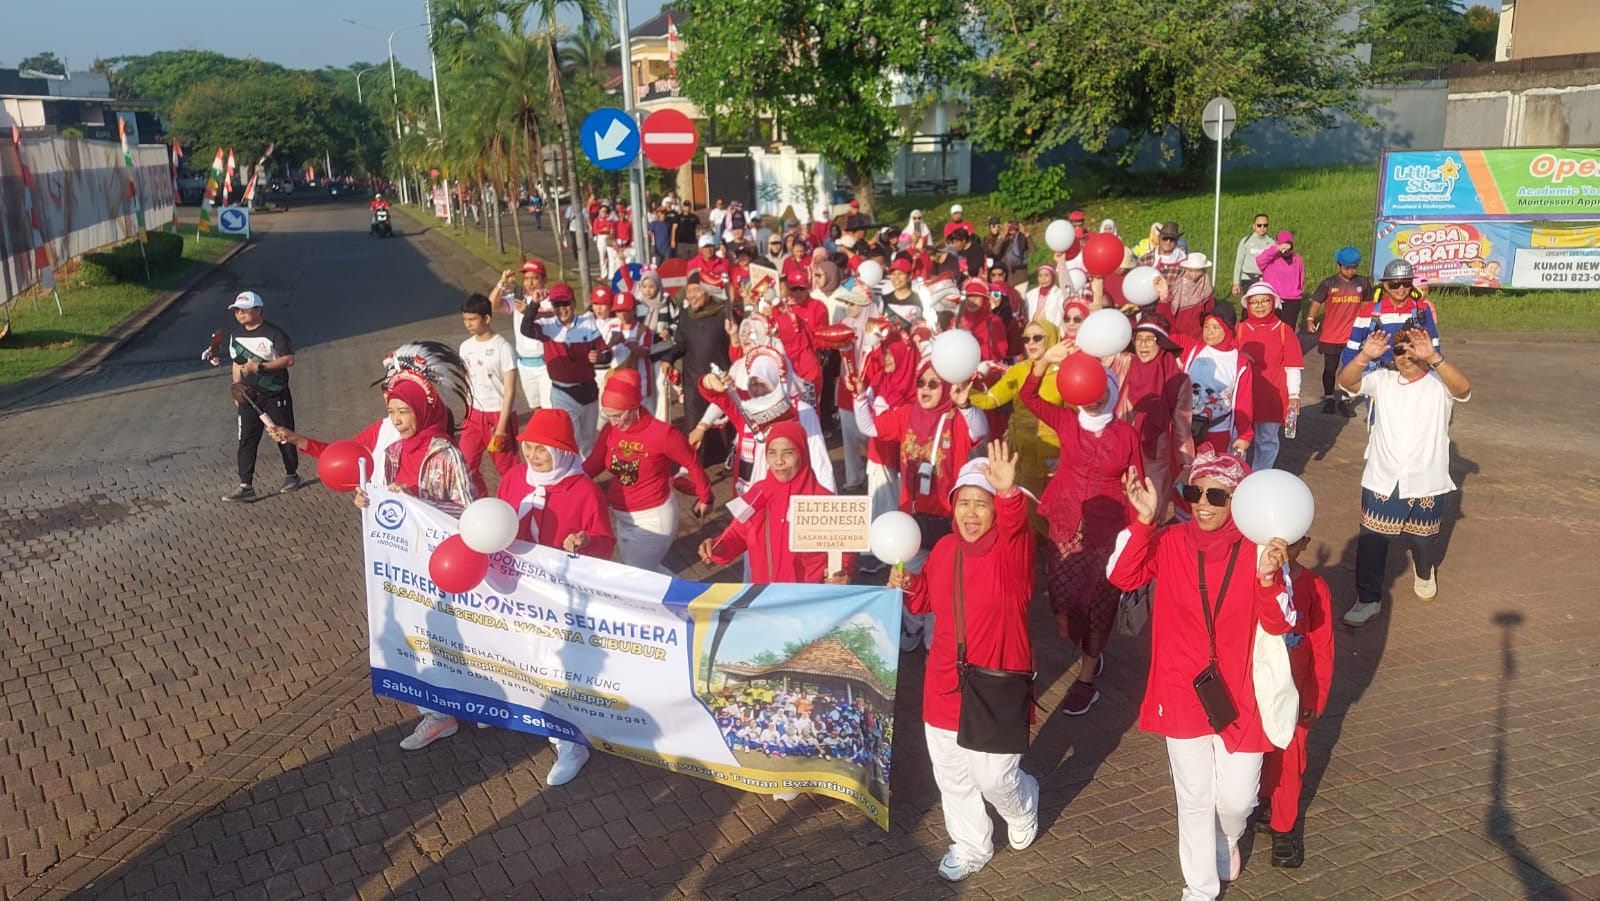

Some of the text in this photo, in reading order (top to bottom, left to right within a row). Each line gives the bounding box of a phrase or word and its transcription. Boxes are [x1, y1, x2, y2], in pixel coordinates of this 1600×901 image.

[1394, 165, 1441, 180] Little
[1530, 153, 1600, 183] Ope
[1406, 179, 1447, 192] Star
[1517, 186, 1578, 197] Academic
[1518, 198, 1574, 206] Montessori
[1409, 228, 1459, 246] COBA
[1404, 243, 1479, 265] GRATIS
[1534, 262, 1600, 270] KUMON NEW
[1541, 273, 1568, 281] (021)
[797, 502, 866, 512] ELTEKERS
[796, 515, 866, 526] INDONESIA
[370, 530, 409, 546] ELTEKERS
[376, 539, 409, 552] INDONESIA
[488, 551, 547, 579] NDONESIA
[373, 561, 678, 647] ELTEKERS INDONESIA SEJAHTERA
[383, 581, 667, 662] SASANA LEGENDA WISATA CIBUBUR
[414, 625, 621, 692] TERAPI KESEHATAN LING TIEN KUNG
[397, 648, 426, 665] Sehat
[432, 660, 463, 675] tanpa
[502, 679, 536, 696] tanpa
[568, 703, 605, 719] tanpa
[610, 713, 648, 726] ragat
[382, 679, 422, 698] Sabtu
[432, 693, 461, 711] Jam
[465, 702, 510, 719] 07.00
[522, 713, 576, 736] Selesai
[731, 772, 778, 788] Taman
[783, 780, 859, 799] Byzantium
